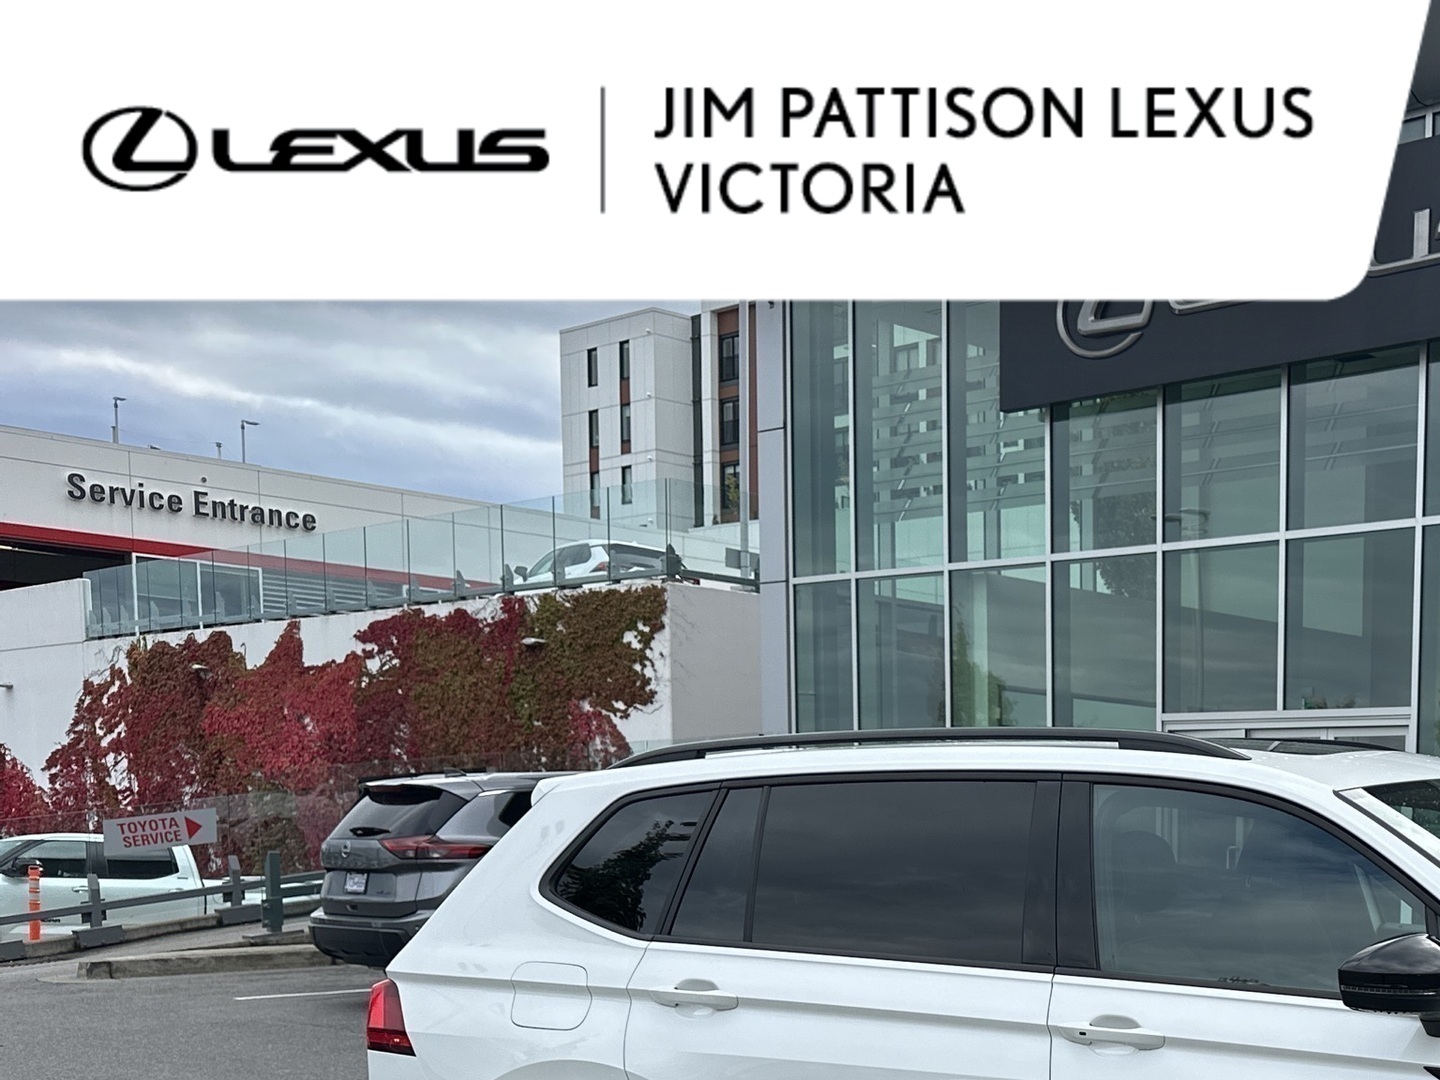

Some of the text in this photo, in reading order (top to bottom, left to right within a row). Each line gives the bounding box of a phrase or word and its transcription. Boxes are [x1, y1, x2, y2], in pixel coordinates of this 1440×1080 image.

[67, 472, 317, 531] Service Entrance
[117, 817, 180, 835] TOYOTA
[122, 830, 182, 848] SERVICE
